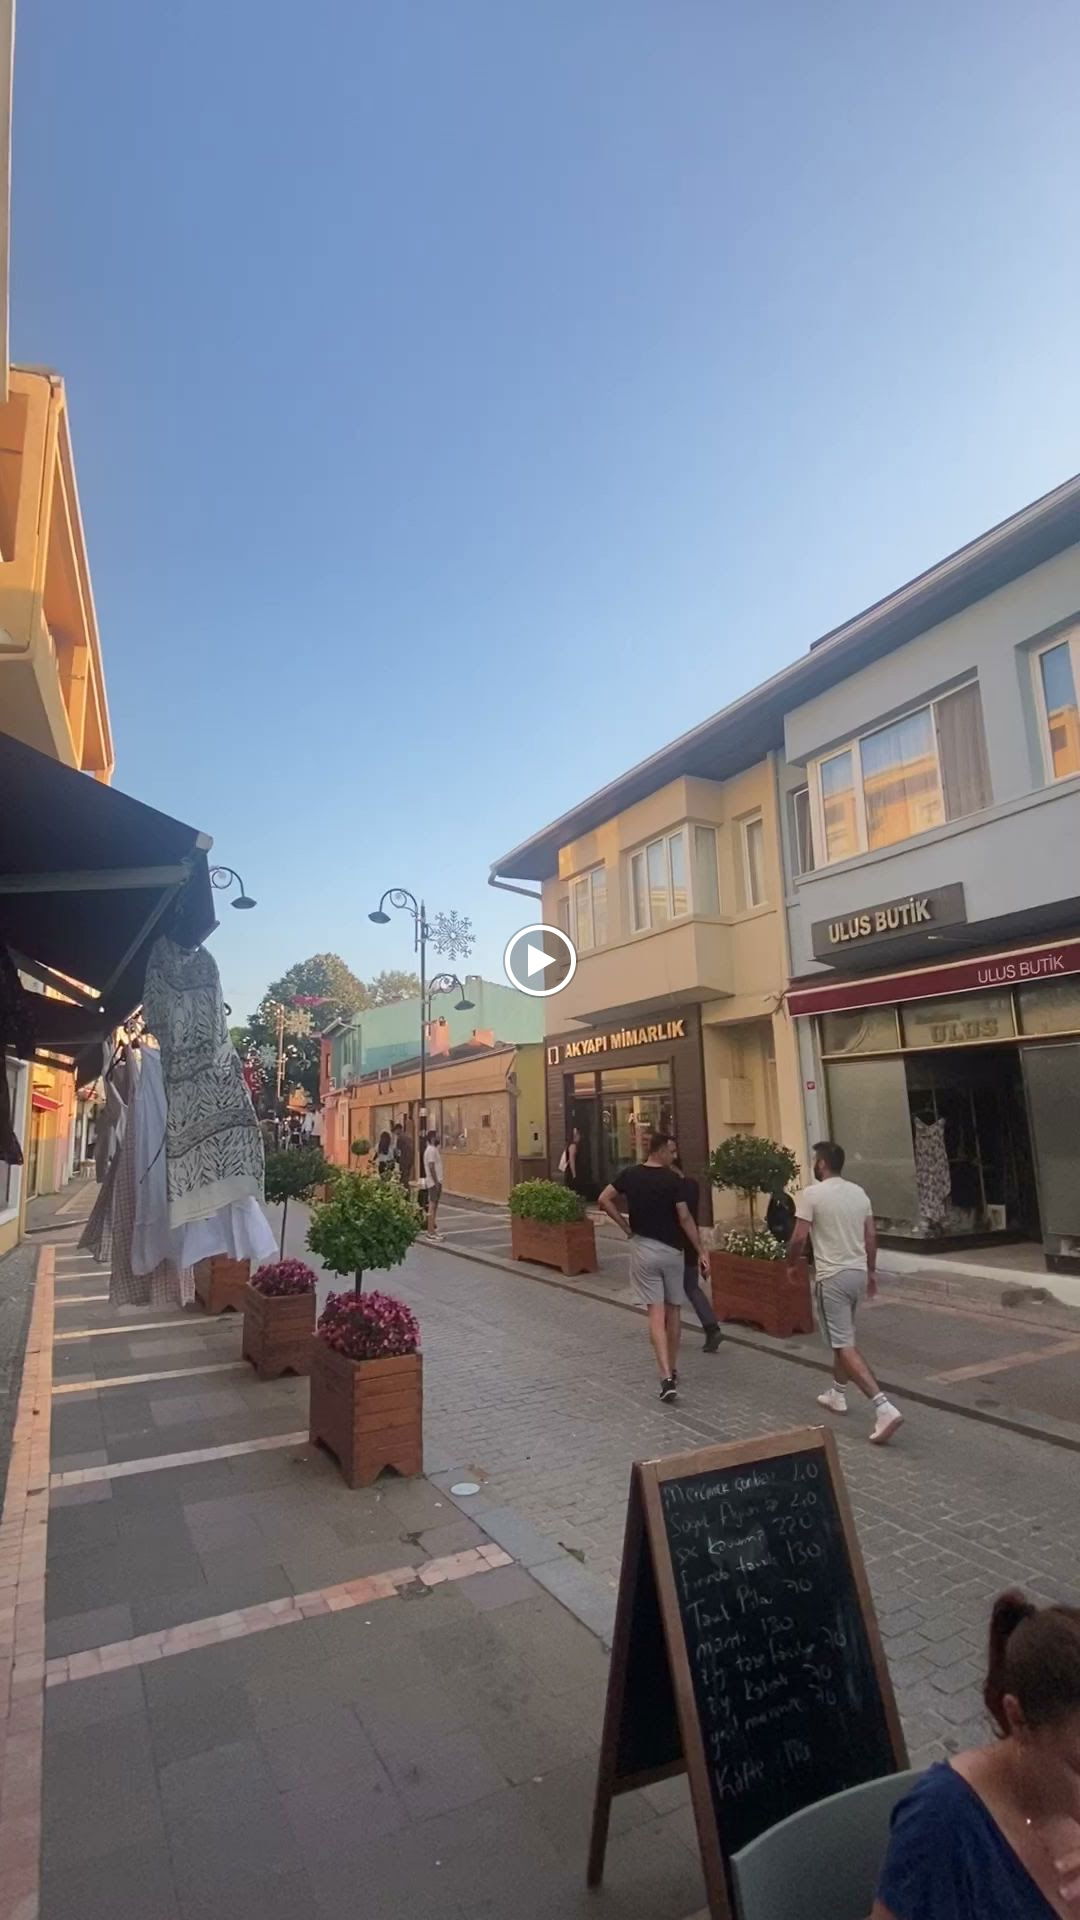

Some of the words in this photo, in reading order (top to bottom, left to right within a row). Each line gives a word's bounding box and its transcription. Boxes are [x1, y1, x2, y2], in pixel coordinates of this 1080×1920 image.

[829, 916, 872, 944] ULUS
[876, 897, 932, 932] BUTİK
[978, 964, 1016, 984] ULUS
[1020, 955, 1065, 977] BUTİK
[565, 1036, 607, 1058] AKYAPI
[611, 1019, 685, 1049] MİMARLIK
